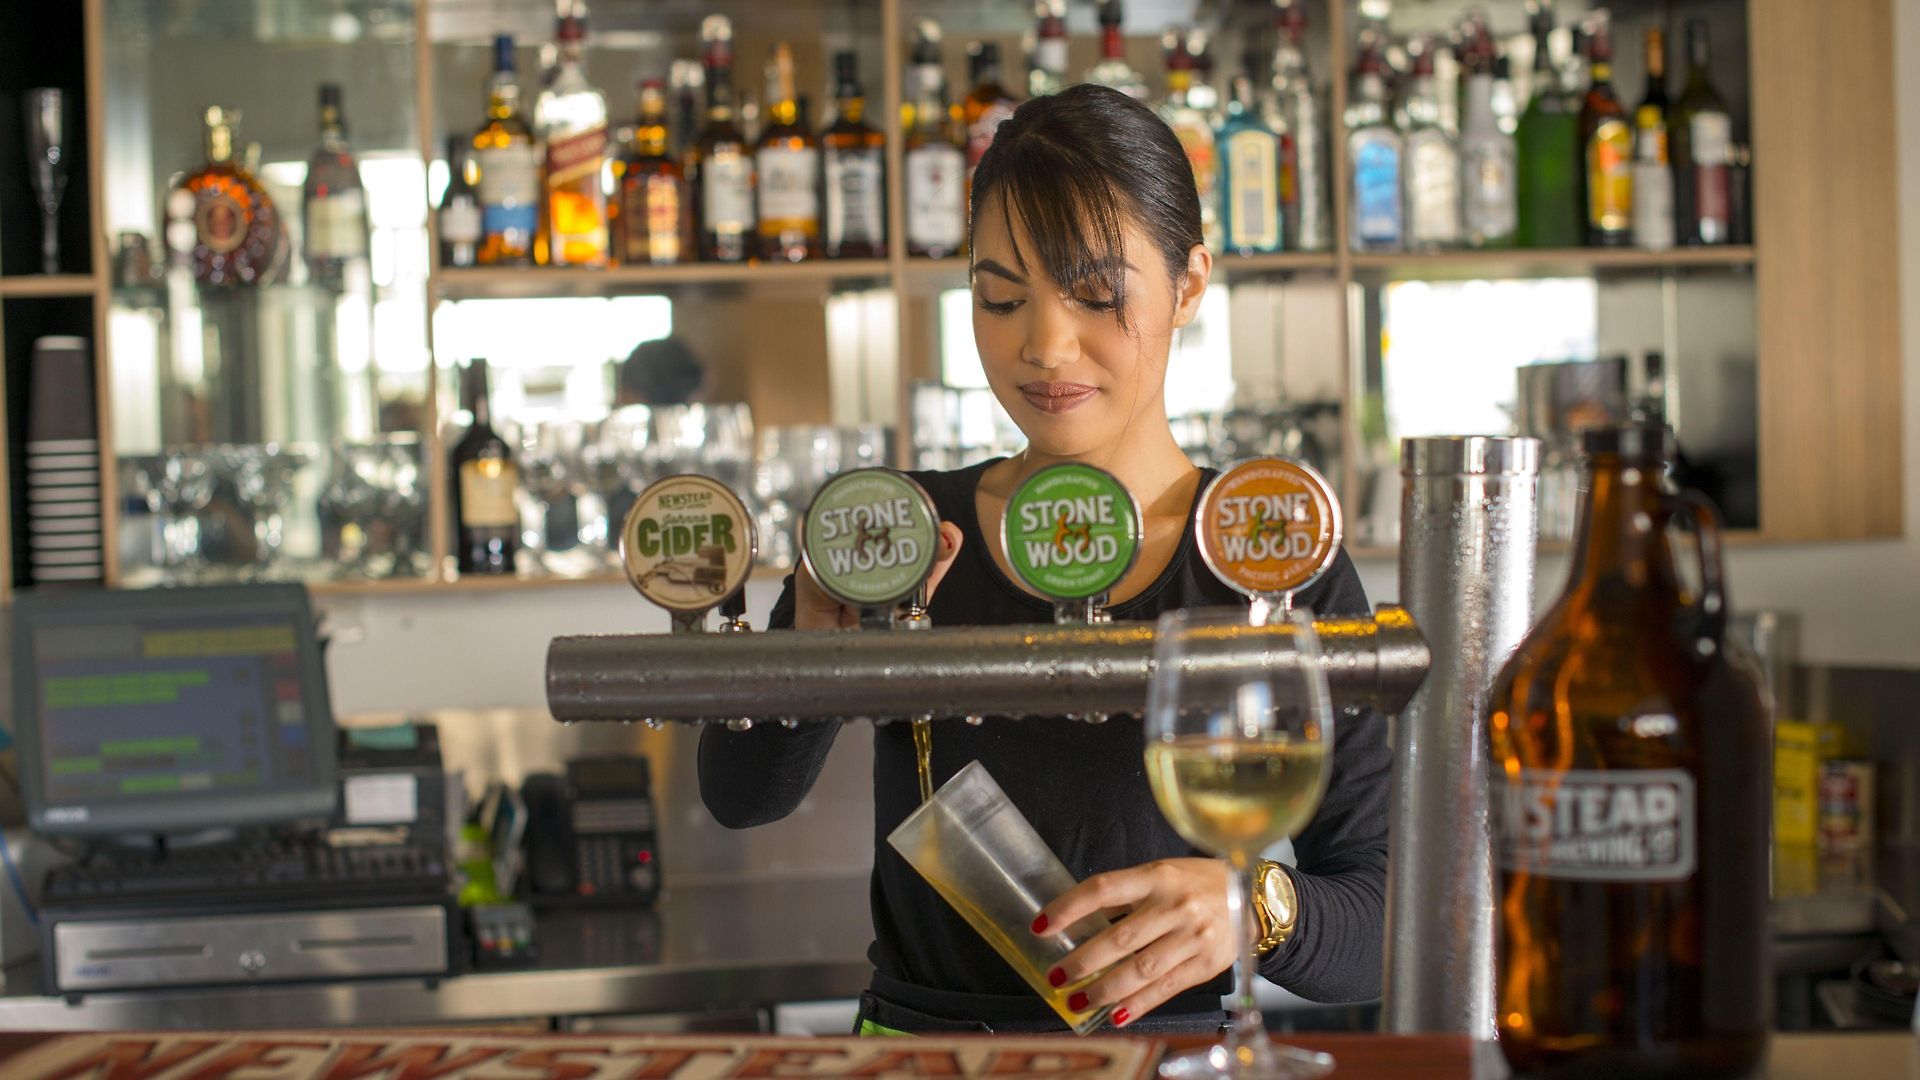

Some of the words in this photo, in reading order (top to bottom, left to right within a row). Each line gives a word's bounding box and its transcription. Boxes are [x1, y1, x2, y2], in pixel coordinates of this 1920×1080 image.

[658, 491, 714, 510] NEWSTEAD
[820, 498, 914, 540] STONE
[1020, 494, 1116, 532] STONE
[1217, 492, 1311, 527] STONE
[637, 513, 737, 559] CIDER
[1024, 535, 1118, 568] WOOD
[1222, 531, 1313, 563] WOOD
[827, 537, 918, 574] WOOD
[38, 1039, 1112, 1080] NEWSTEAD
